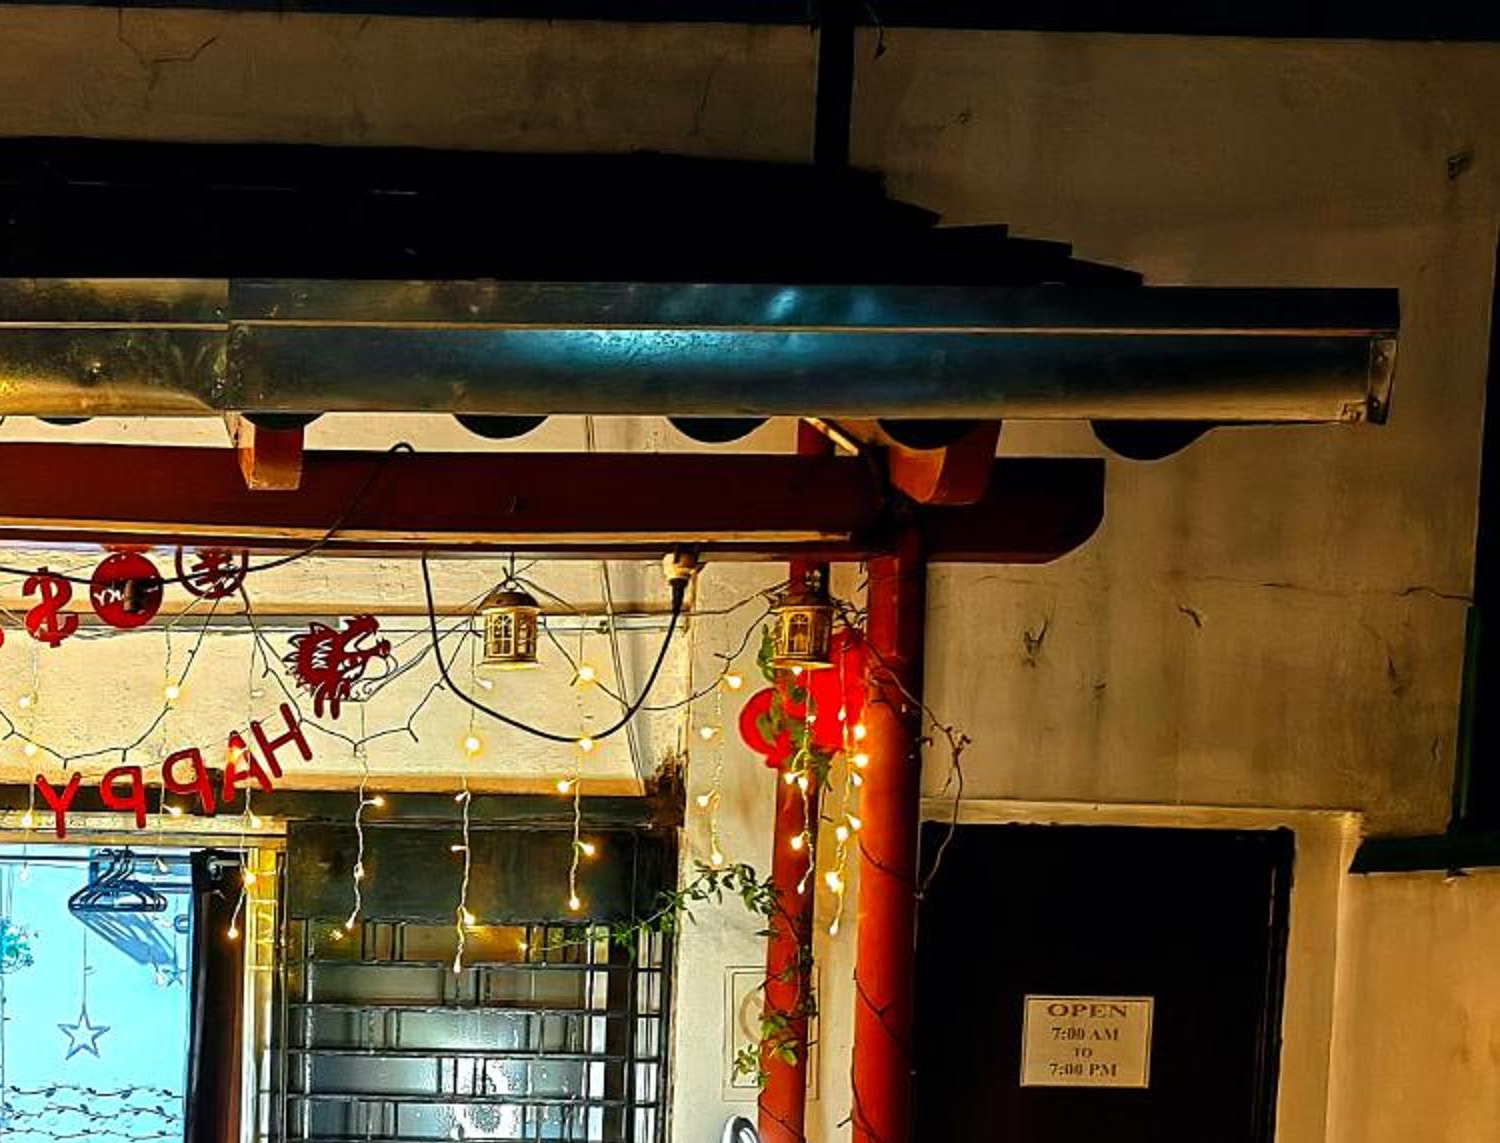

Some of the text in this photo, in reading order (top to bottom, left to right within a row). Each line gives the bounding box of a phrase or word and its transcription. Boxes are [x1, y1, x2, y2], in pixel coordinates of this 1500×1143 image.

[1047, 1003, 1128, 1018] OPEN
[1051, 1027, 1119, 1041] 7:00 AM
[1074, 1047, 1093, 1058] TO
[1049, 1063, 1117, 1077] 7:00 PM
